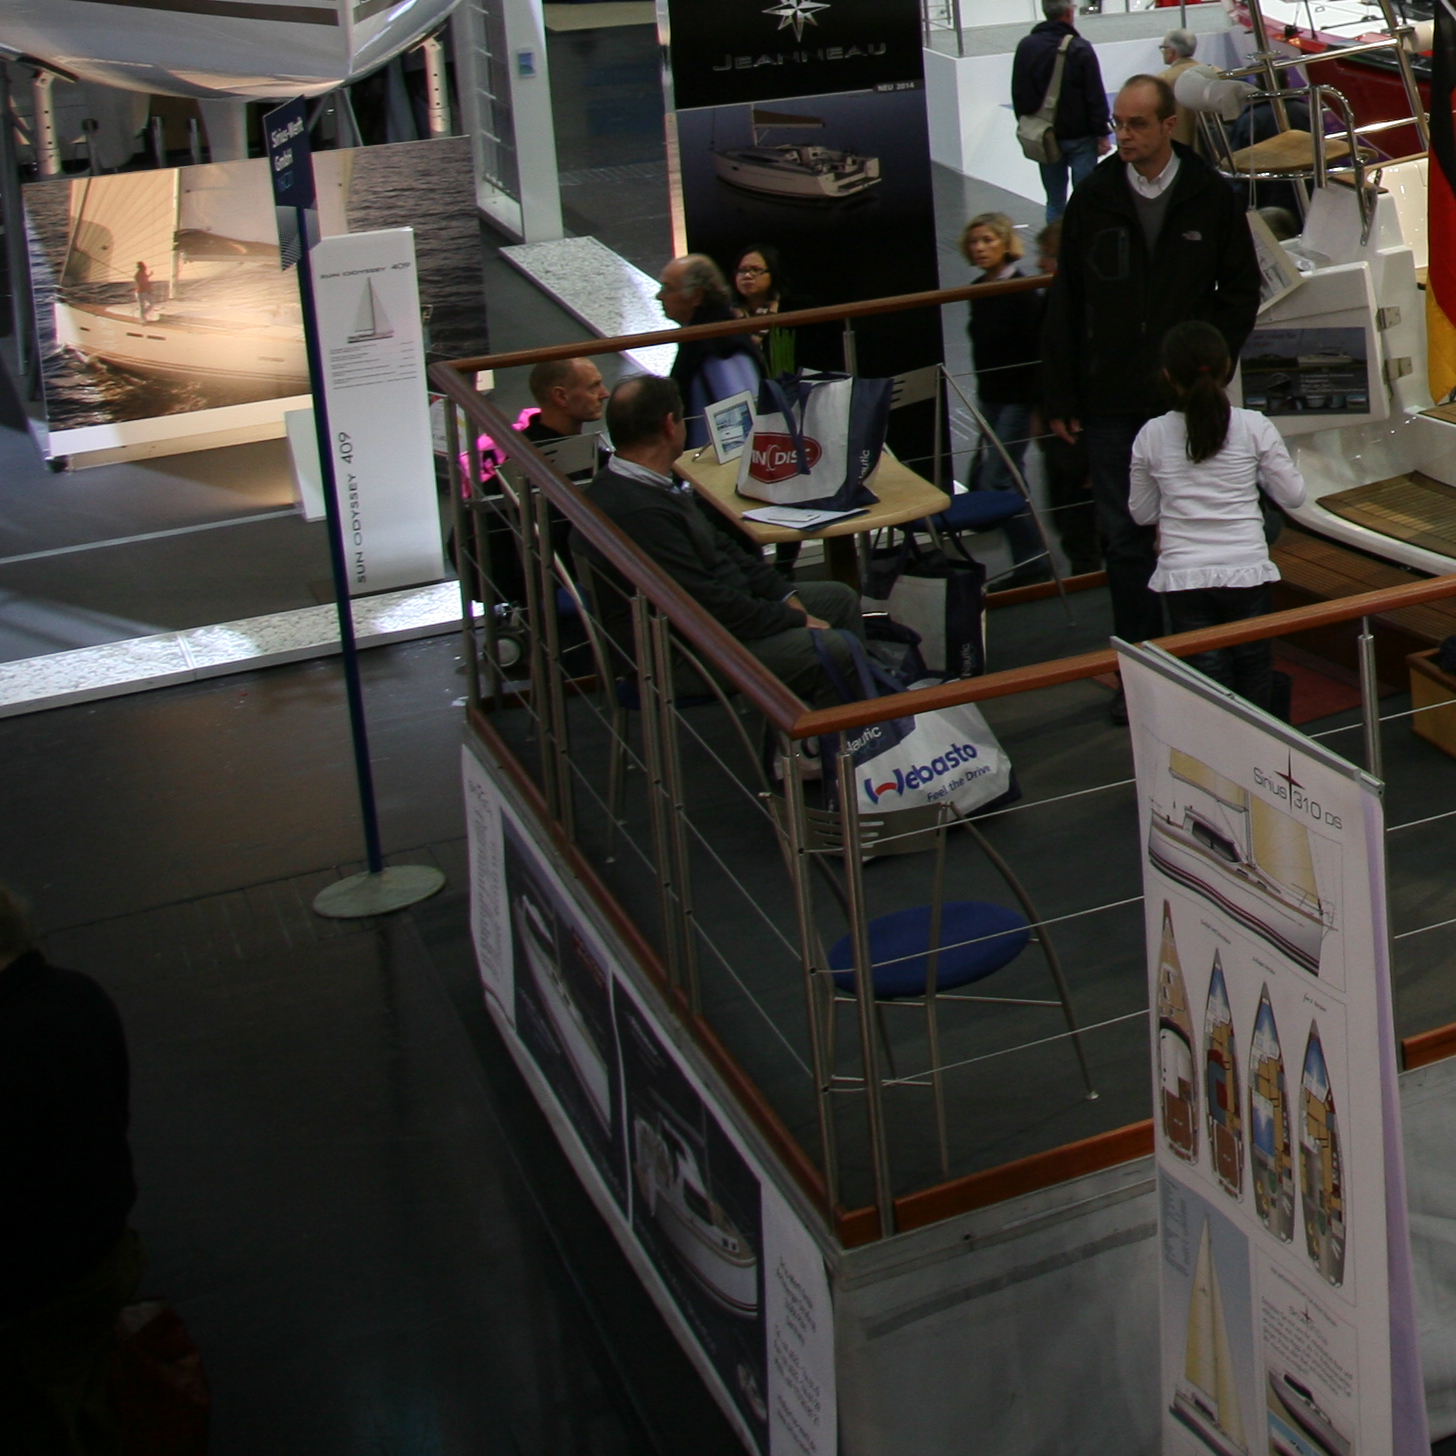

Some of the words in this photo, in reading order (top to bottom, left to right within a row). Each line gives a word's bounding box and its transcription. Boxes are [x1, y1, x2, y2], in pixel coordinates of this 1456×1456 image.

[712, 42, 887, 72] JEANNEAU
[320, 272, 340, 280] SUN
[391, 261, 411, 271] 409
[338, 432, 354, 464] 409
[348, 473, 363, 546] ODYSSEY
[355, 551, 366, 583] SUN
[864, 743, 978, 804] Webasto
[926, 786, 949, 802] Feel
[948, 777, 965, 793] the
[965, 765, 992, 782] Drive
[1253, 766, 1288, 800] Sirius
[1293, 790, 1322, 820] 310
[1325, 811, 1343, 830] DS
